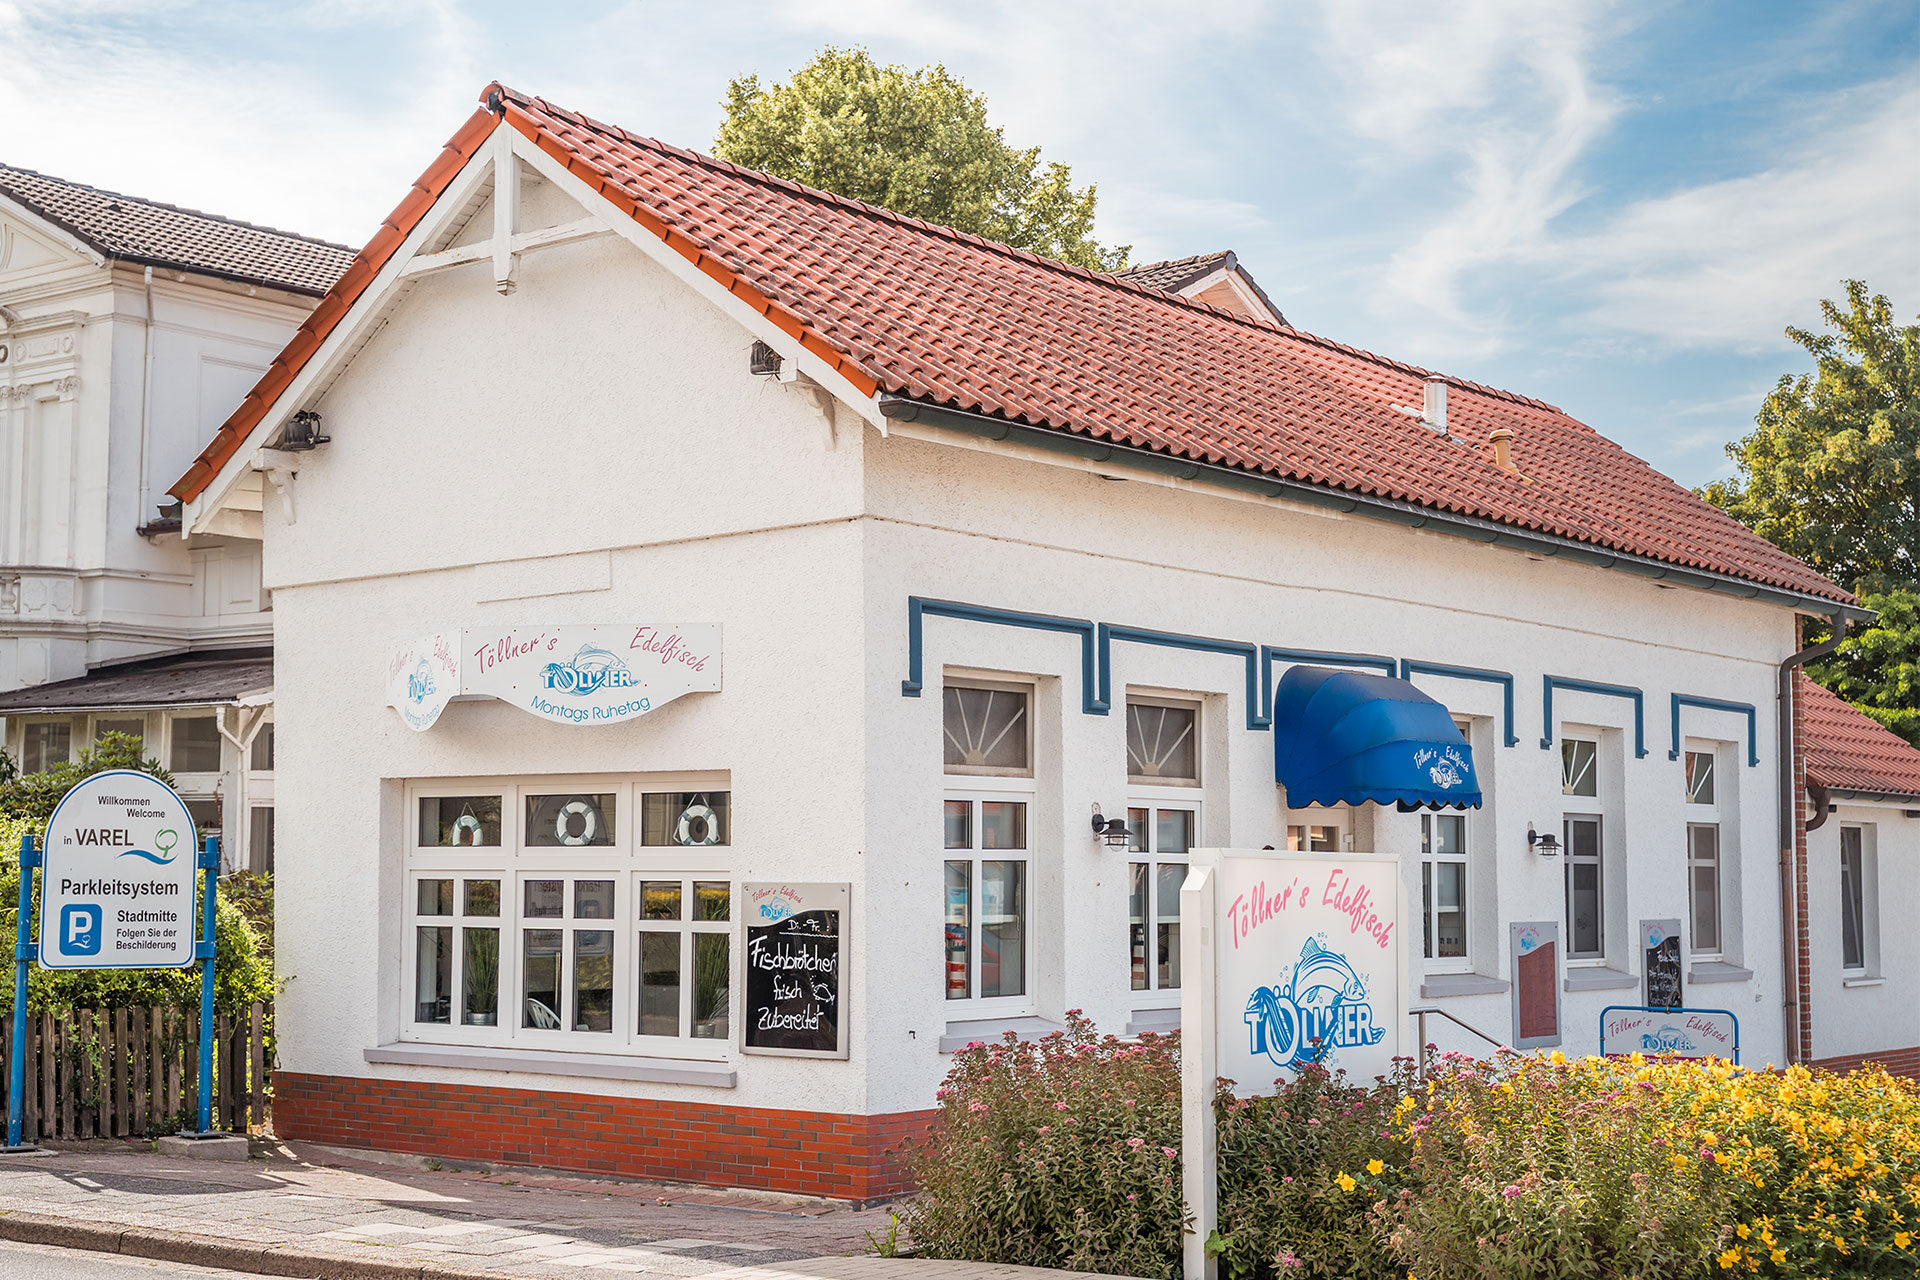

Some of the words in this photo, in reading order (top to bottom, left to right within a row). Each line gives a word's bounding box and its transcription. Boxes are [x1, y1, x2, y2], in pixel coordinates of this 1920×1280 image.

[629, 627, 714, 672] Edelfisch
[530, 696, 589, 720] Montags
[592, 696, 651, 720] Ruhetag
[97, 795, 151, 806] Willkommen
[126, 808, 166, 819] Welcome
[63, 835, 72, 845] in
[75, 828, 134, 846] VAREL
[60, 878, 179, 899] Parkleitsystem
[117, 910, 178, 922] Stadtmitte
[1321, 868, 1394, 949] Edelfisch
[116, 928, 146, 939] Folgen
[148, 928, 161, 937] Sie
[163, 928, 177, 937] der
[116, 940, 177, 951] Beschilderung
[748, 934, 837, 973] Fischbrötchen
[773, 975, 803, 1001] frisch
[1685, 1015, 1729, 1043] Edelfisch
